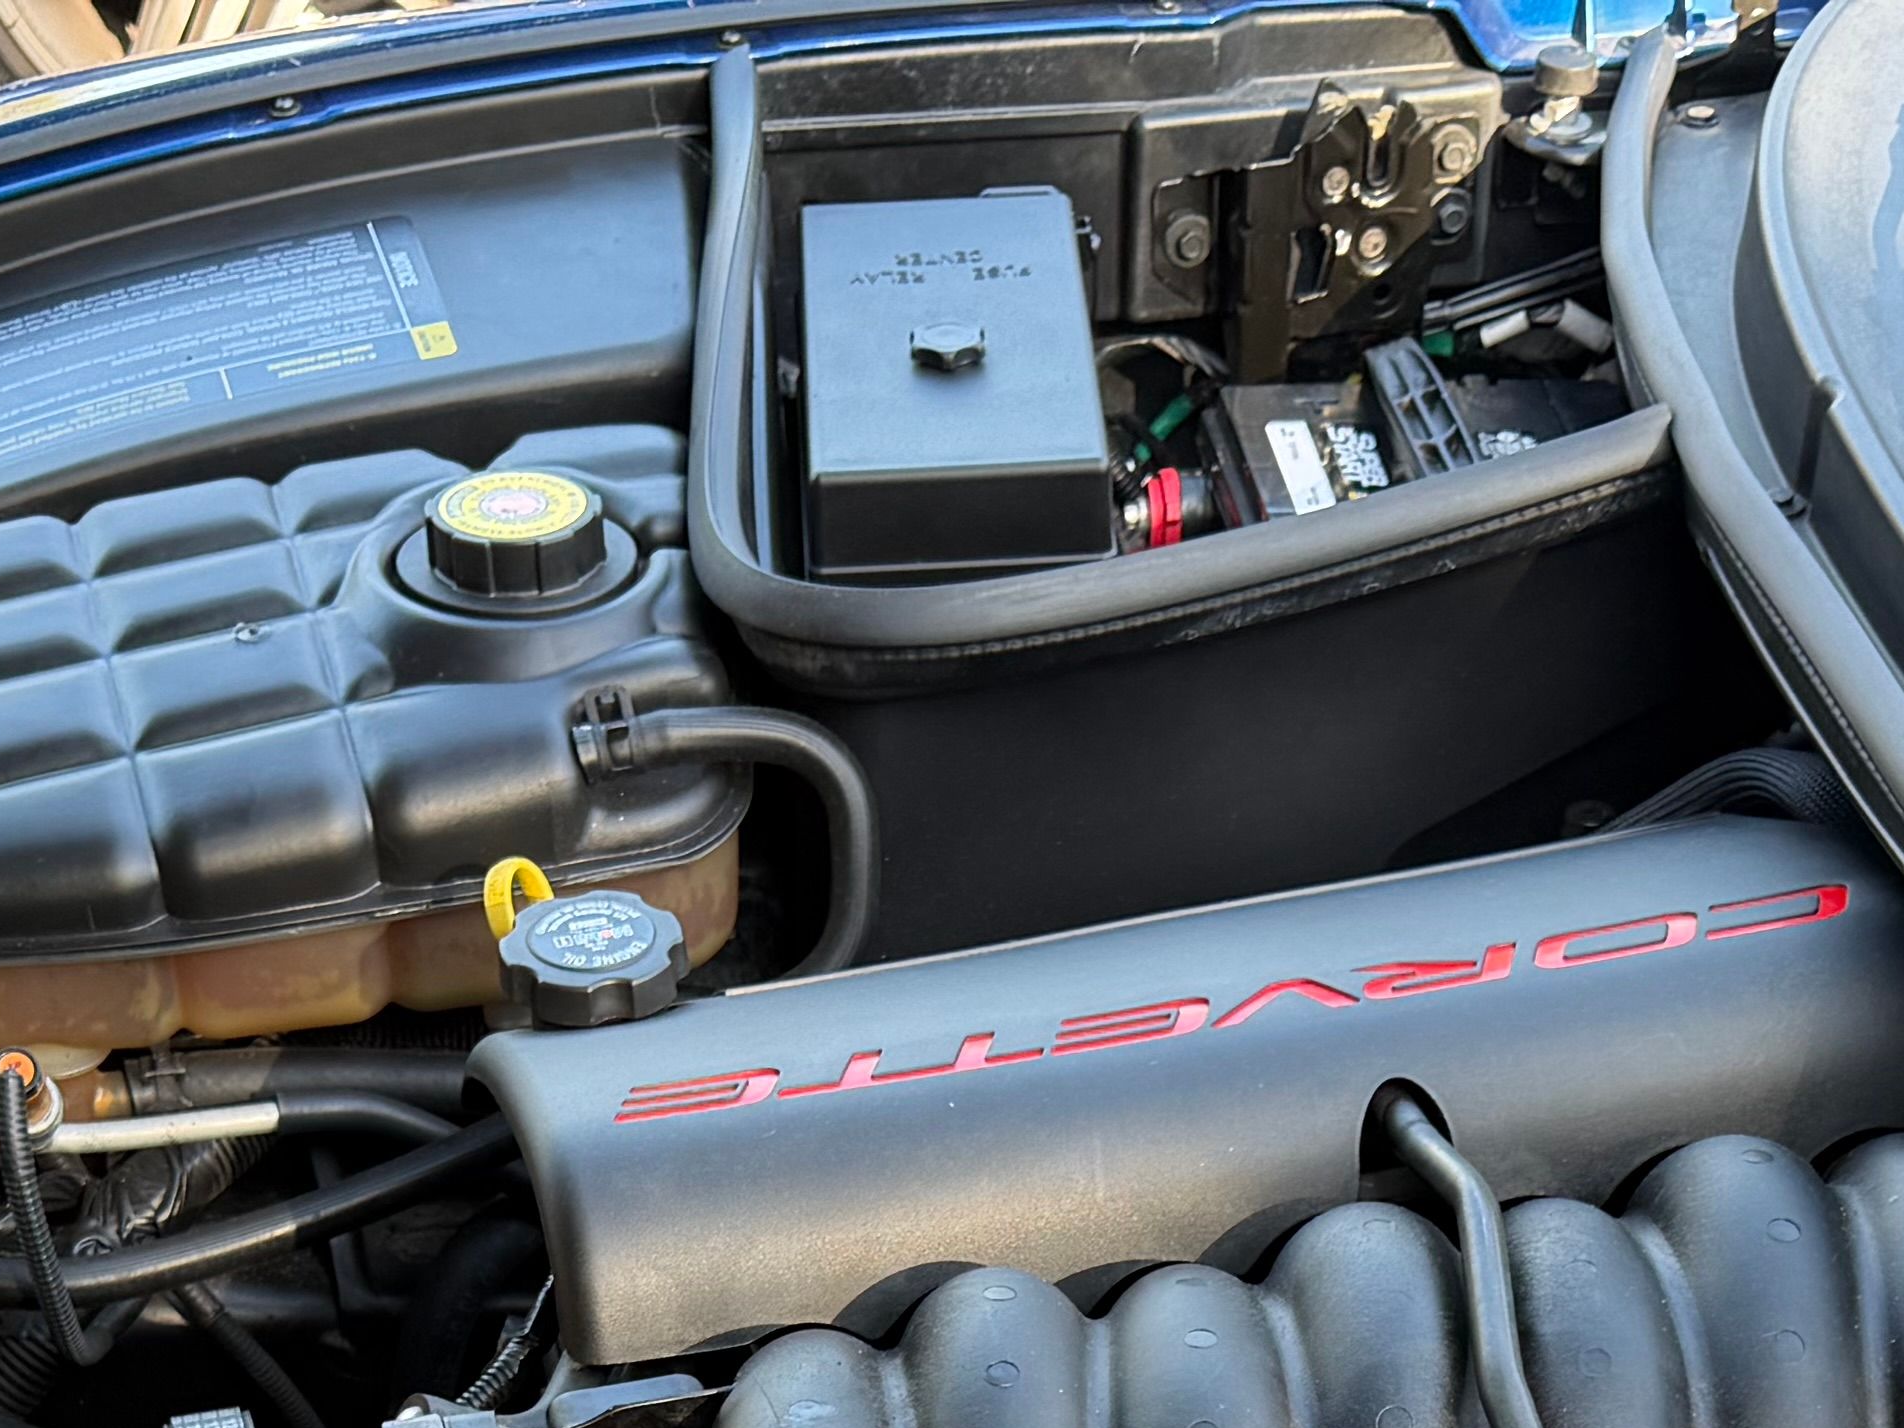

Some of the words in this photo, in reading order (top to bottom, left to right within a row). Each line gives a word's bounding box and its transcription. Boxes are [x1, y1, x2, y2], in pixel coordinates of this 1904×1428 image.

[561, 951, 587, 966] OIL
[592, 941, 649, 968] ENGINE
[611, 882, 1850, 1125] CORVETTE
